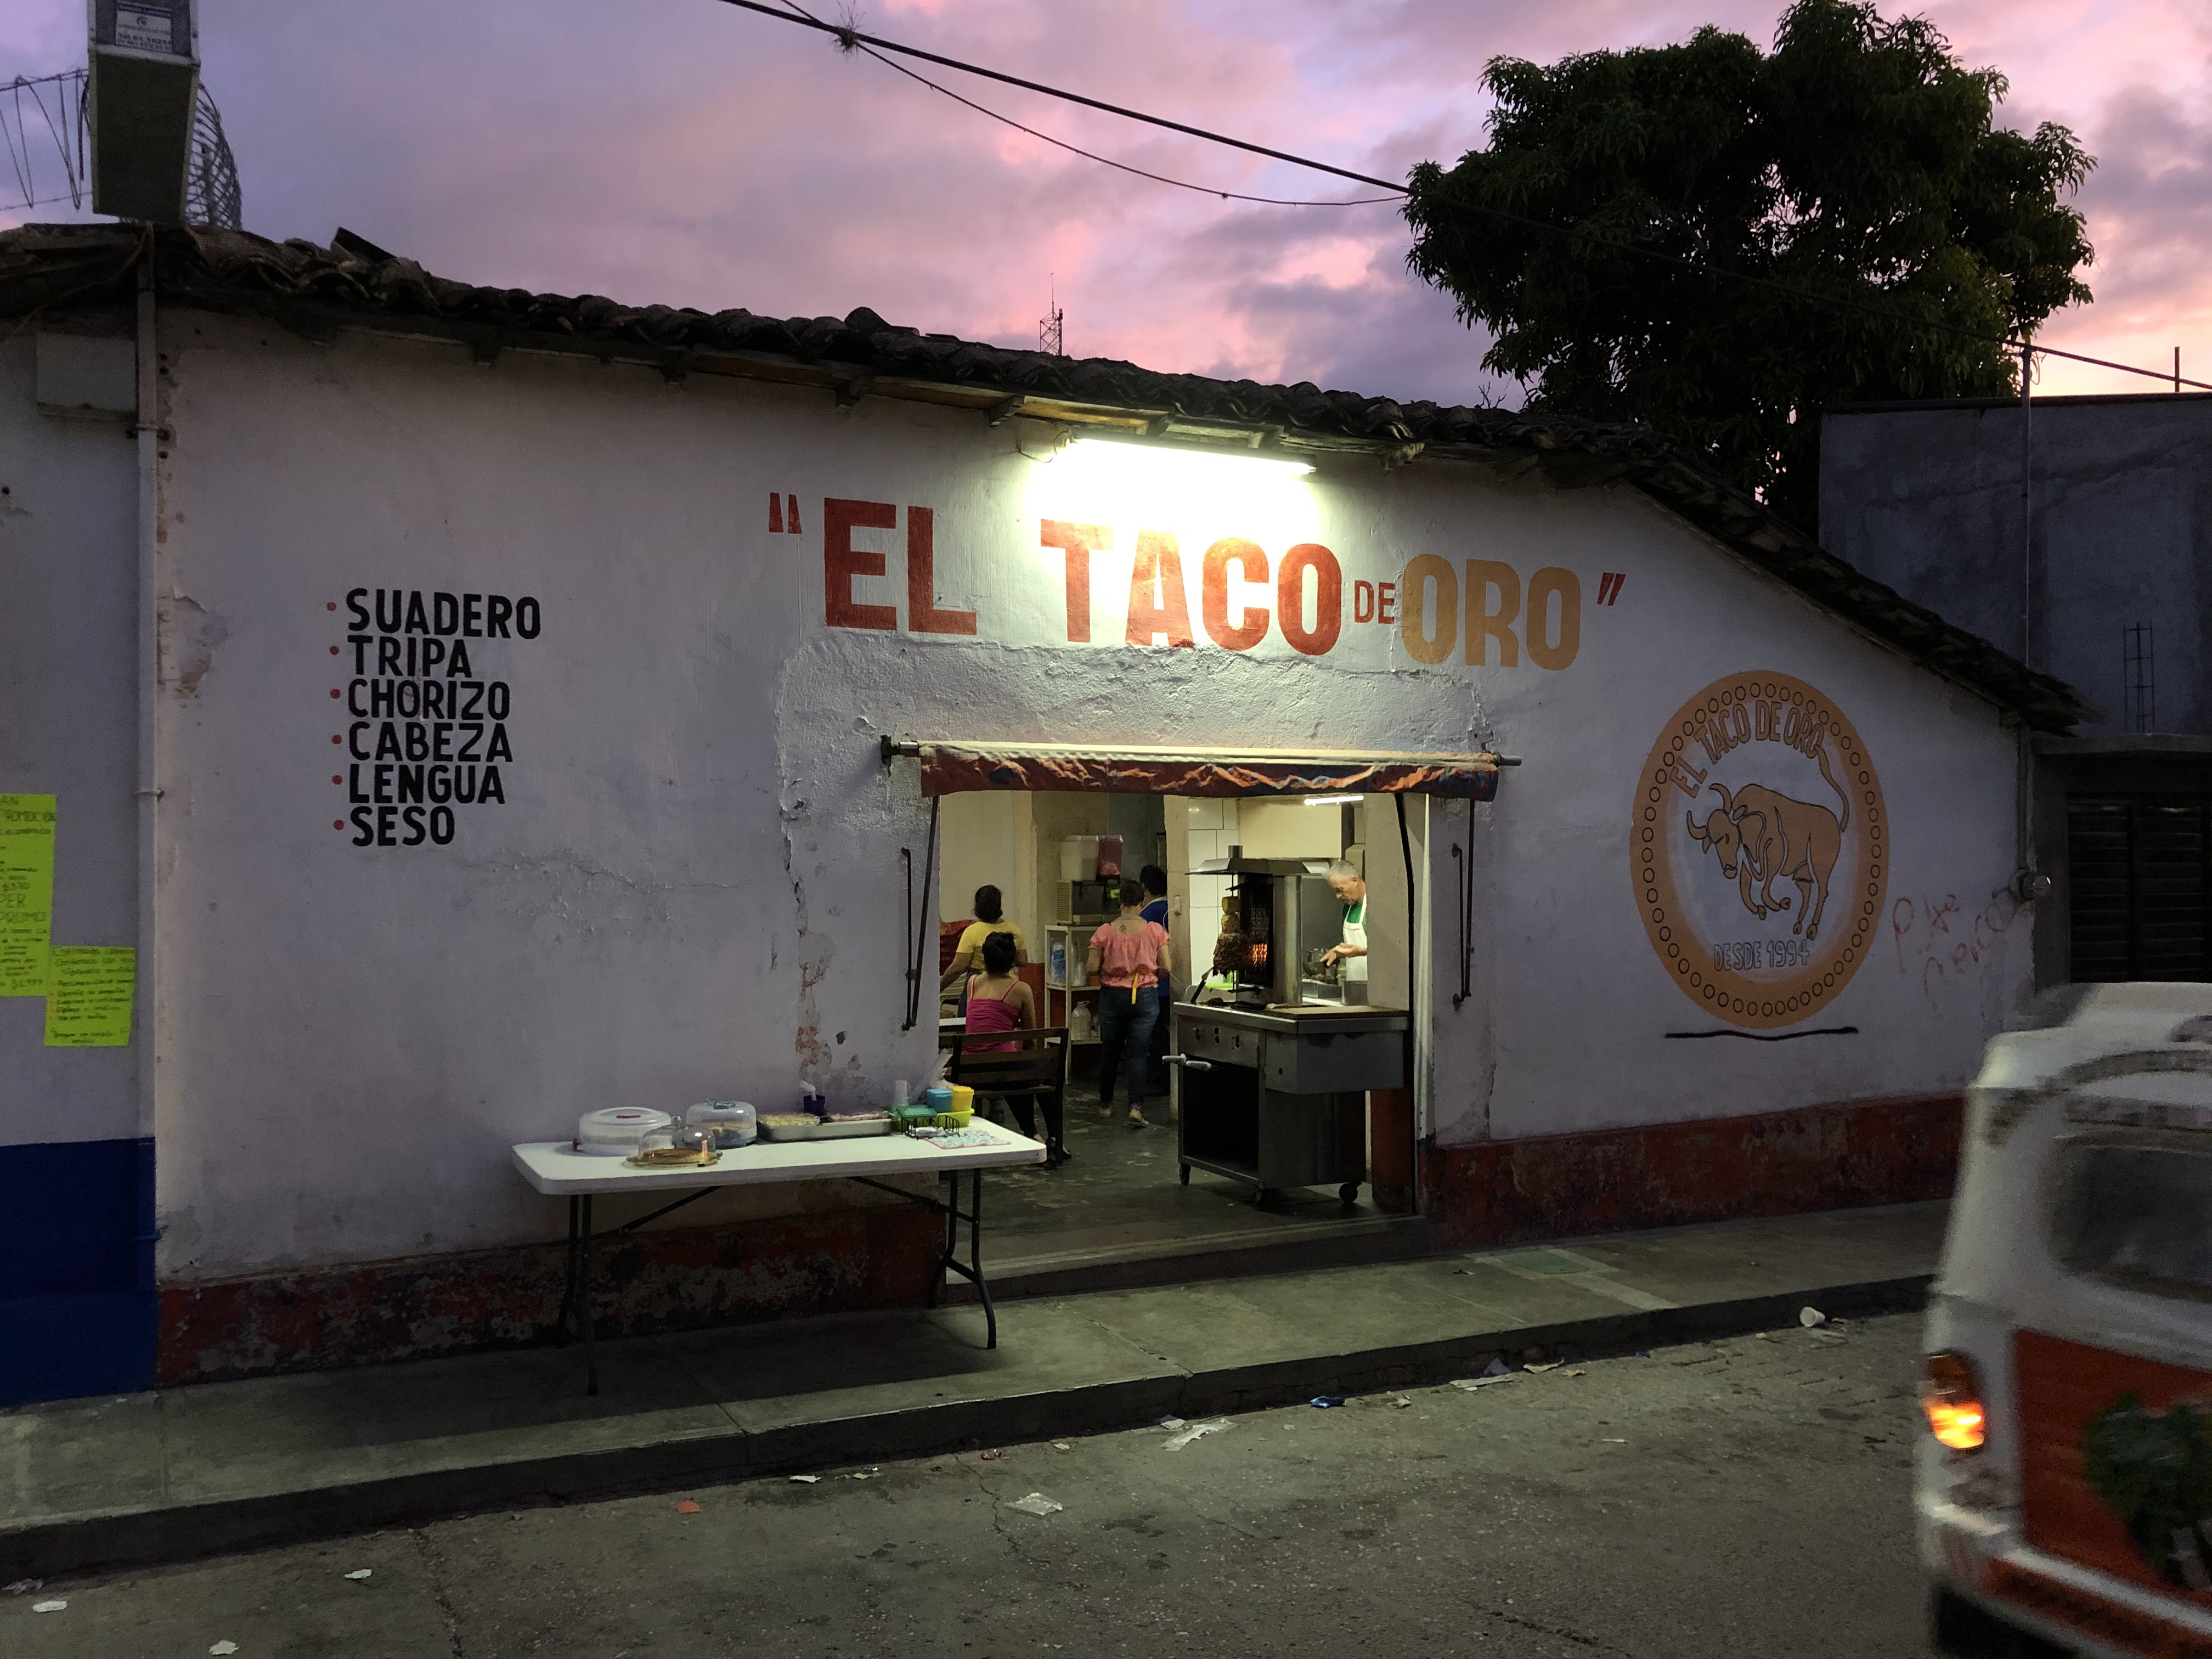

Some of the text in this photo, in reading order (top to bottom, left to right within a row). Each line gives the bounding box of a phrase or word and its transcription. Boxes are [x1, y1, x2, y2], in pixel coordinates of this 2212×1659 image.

[1040, 518, 1342, 656] TACO
[1354, 579, 1396, 624] DE
[346, 588, 541, 640] SUADERO
[347, 635, 472, 678] TRIPA
[348, 678, 510, 720] CHORIZO
[349, 721, 514, 763] CABEZA
[1669, 699, 1824, 799] EL TACO DE ORO
[349, 763, 506, 805] LENGUA
[350, 805, 455, 847] SESO
[1713, 939, 1809, 972] DESDE 1994
